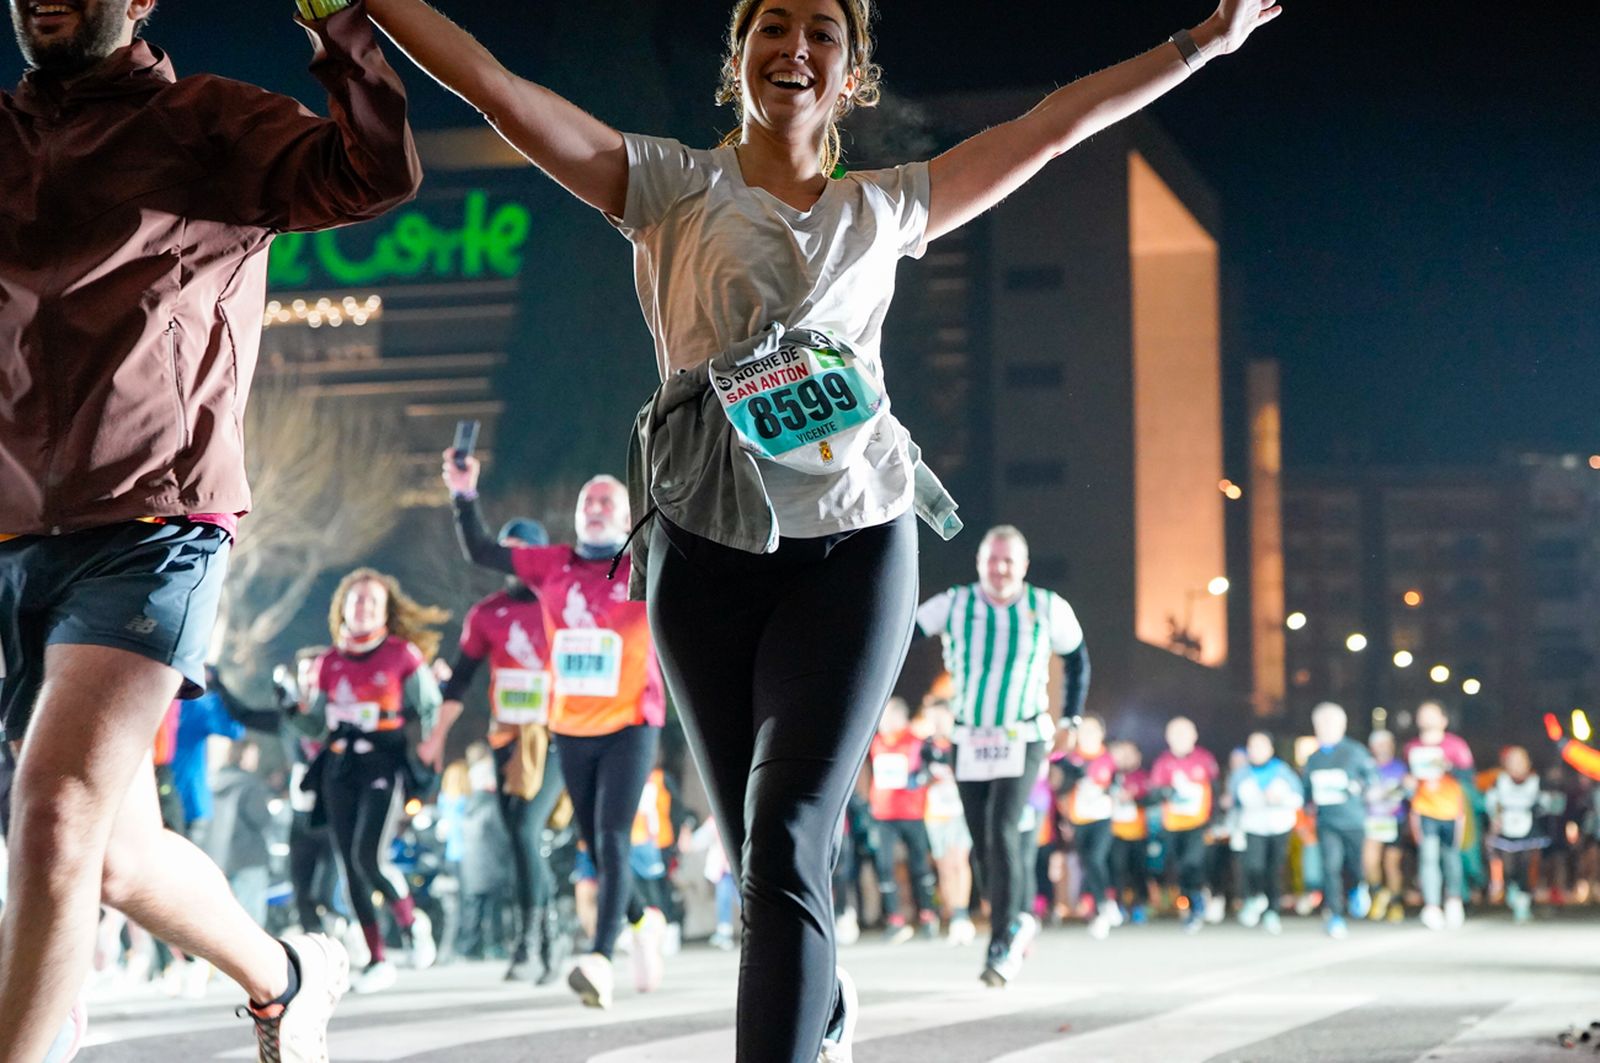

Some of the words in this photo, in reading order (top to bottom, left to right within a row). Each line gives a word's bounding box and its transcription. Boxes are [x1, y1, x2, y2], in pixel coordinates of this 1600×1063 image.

[726, 381, 759, 404] SAN
[760, 362, 809, 392] ANTÓN
[735, 354, 781, 384] NOCHE
[782, 346, 800, 364] DE
[747, 372, 858, 440] 8599
[796, 421, 838, 443] VICENTE
